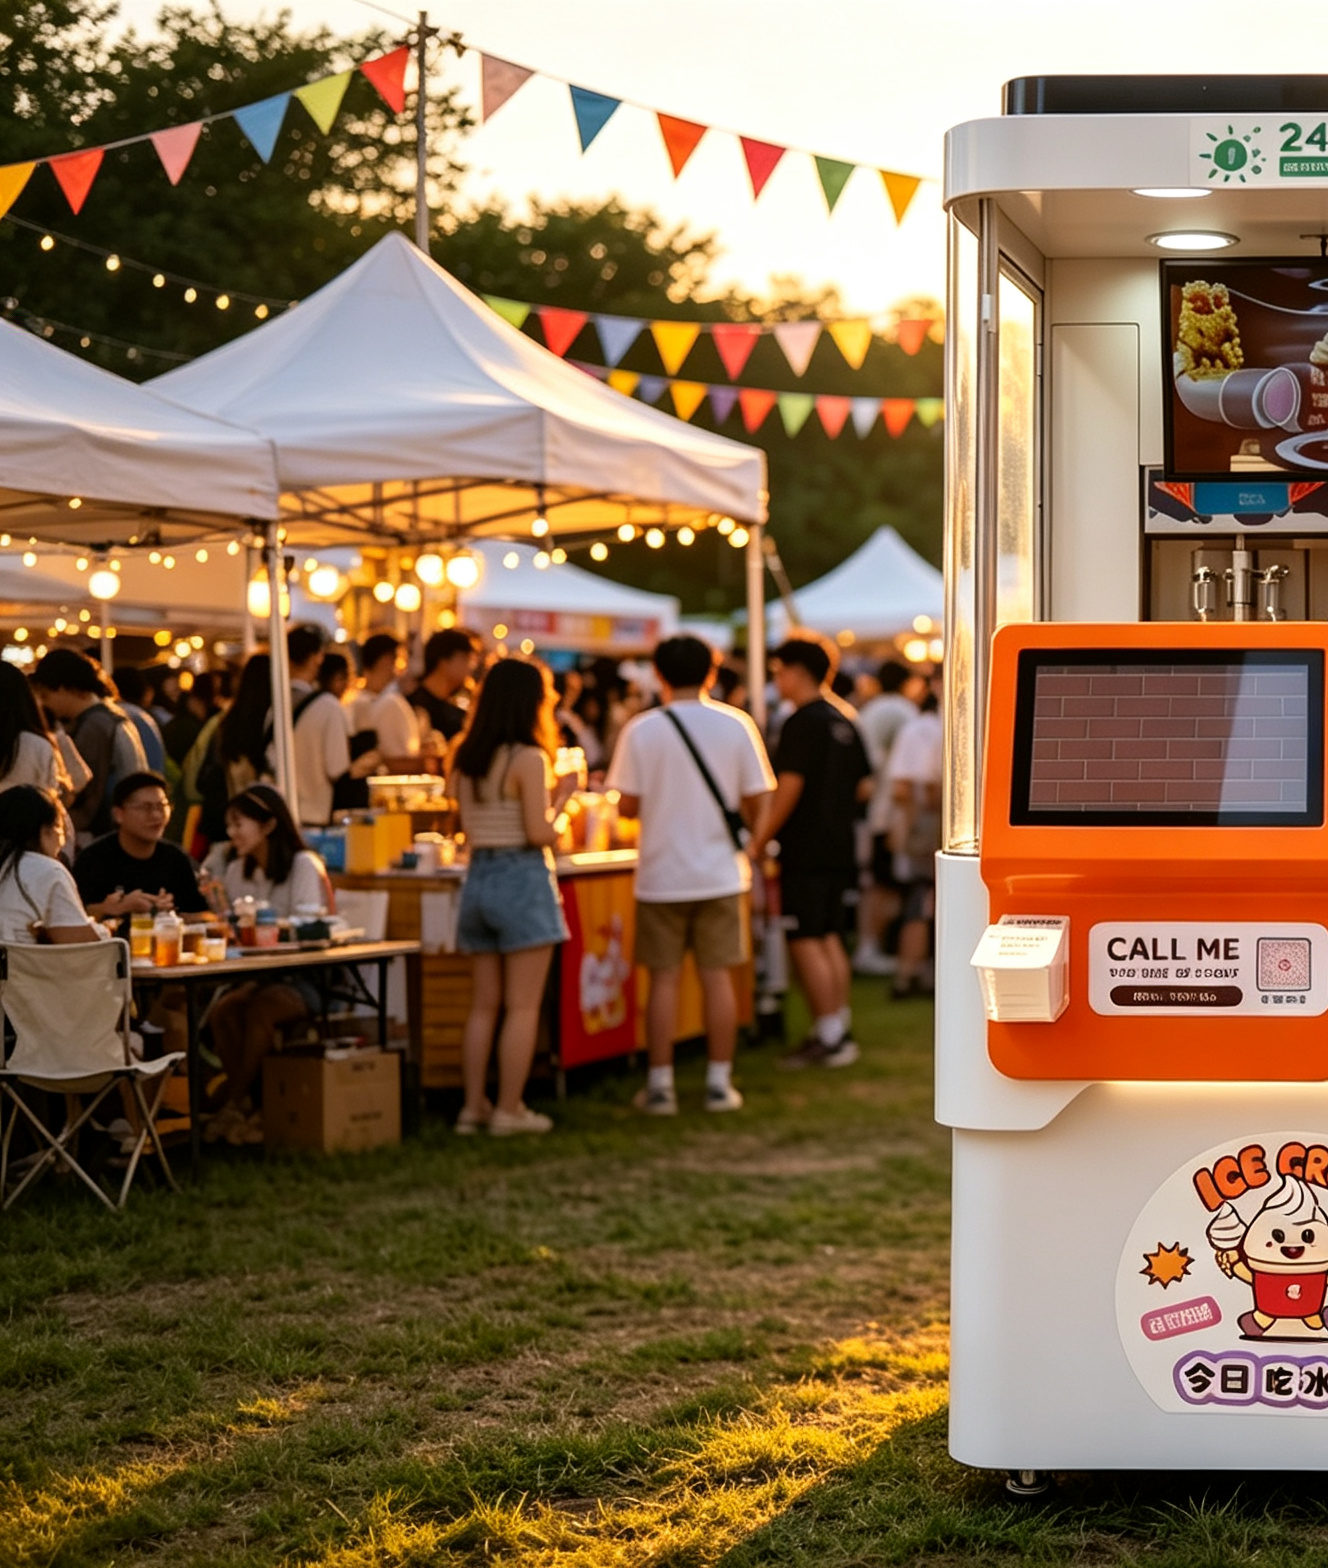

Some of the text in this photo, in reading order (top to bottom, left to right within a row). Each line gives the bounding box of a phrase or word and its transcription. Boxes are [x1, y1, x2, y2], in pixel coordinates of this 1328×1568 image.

[1279, 122, 1327, 152] 24
[1107, 937, 1240, 961] CALL ME
[1193, 1144, 1271, 1212] ICE
